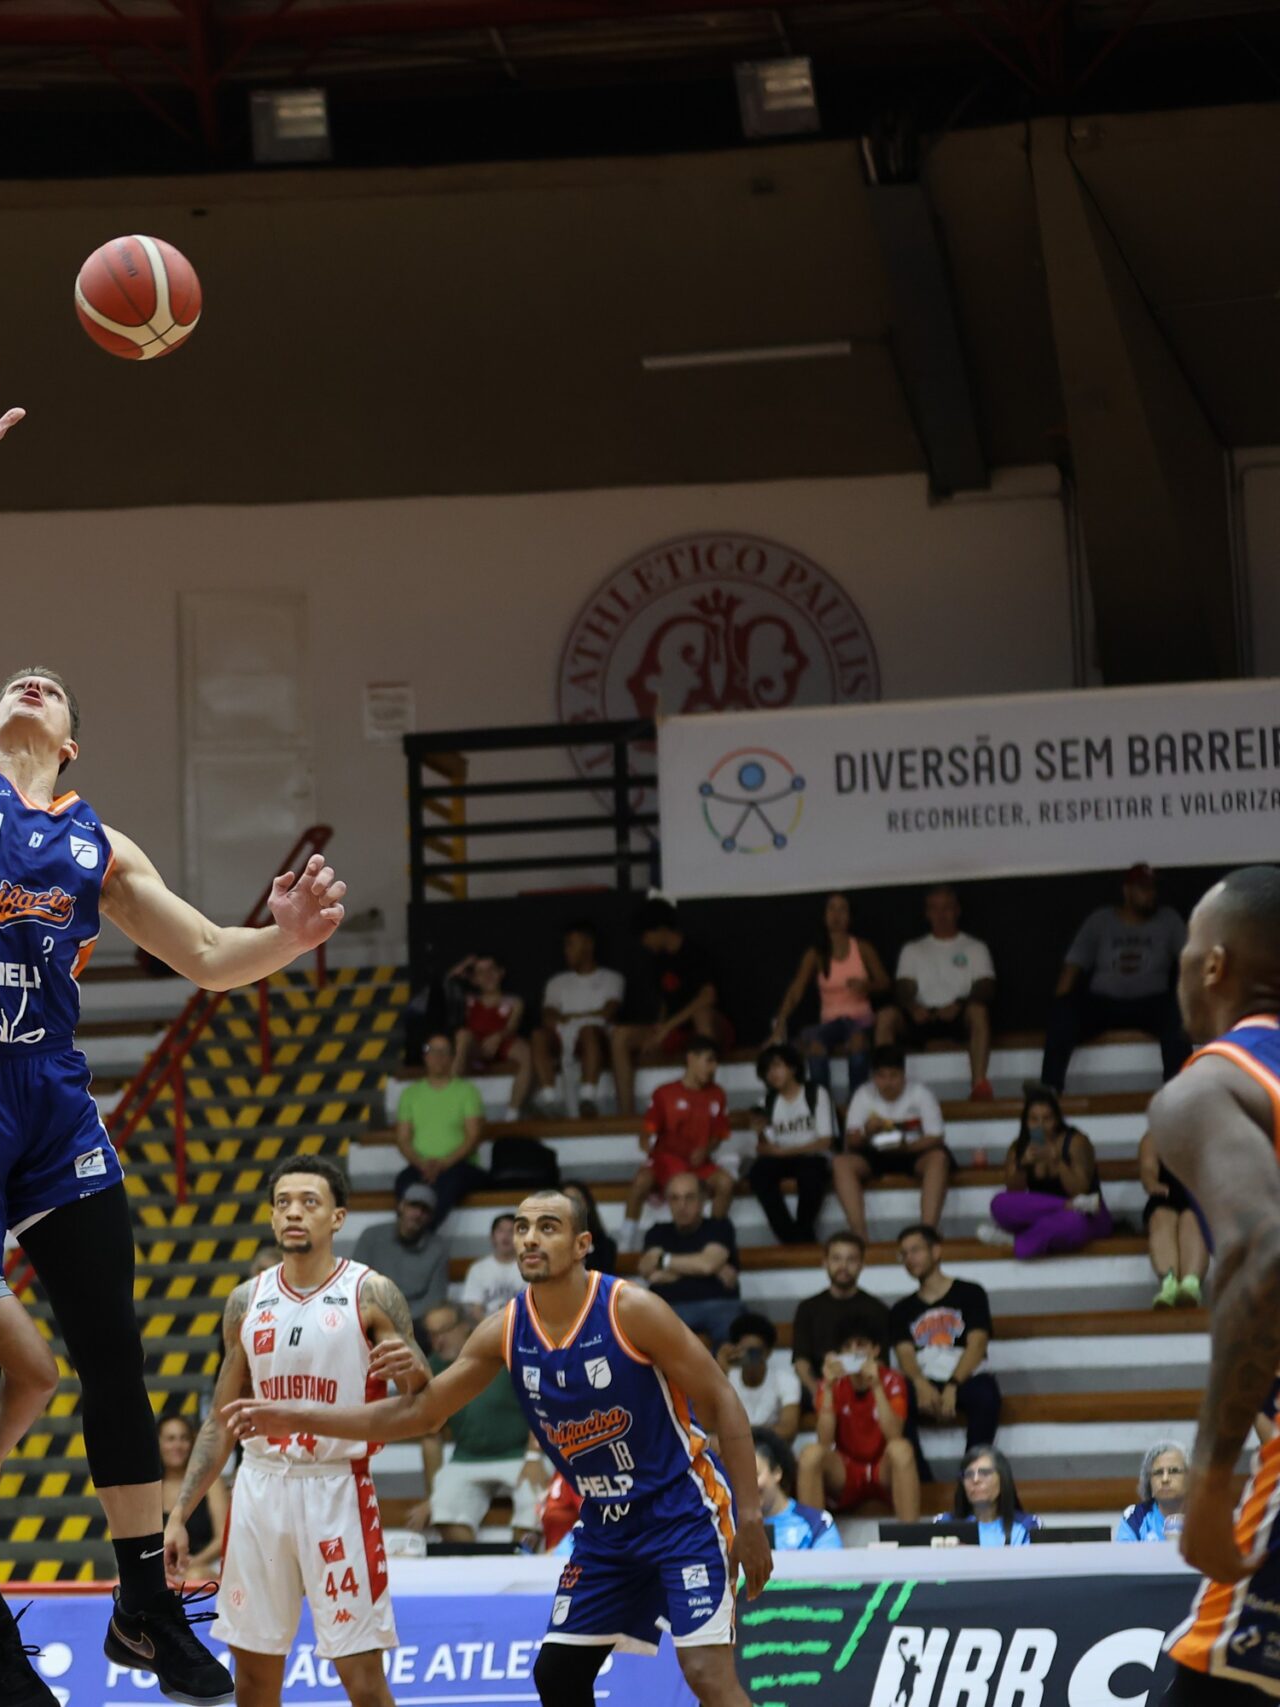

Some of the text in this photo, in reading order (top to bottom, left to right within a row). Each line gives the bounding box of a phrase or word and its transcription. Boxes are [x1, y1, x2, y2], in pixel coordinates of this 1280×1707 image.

[569, 541, 870, 698] ATHLETICO PAULIS
[835, 735, 1021, 795] DIVERSÃO
[1035, 738, 1115, 783] SEM
[887, 802, 1032, 834] RECONHECER,
[1040, 795, 1154, 825] RESPEITAR
[1162, 794, 1173, 816] E
[608, 1440, 636, 1472] 18
[576, 1473, 634, 1498] HELP
[325, 1565, 360, 1602] 44
